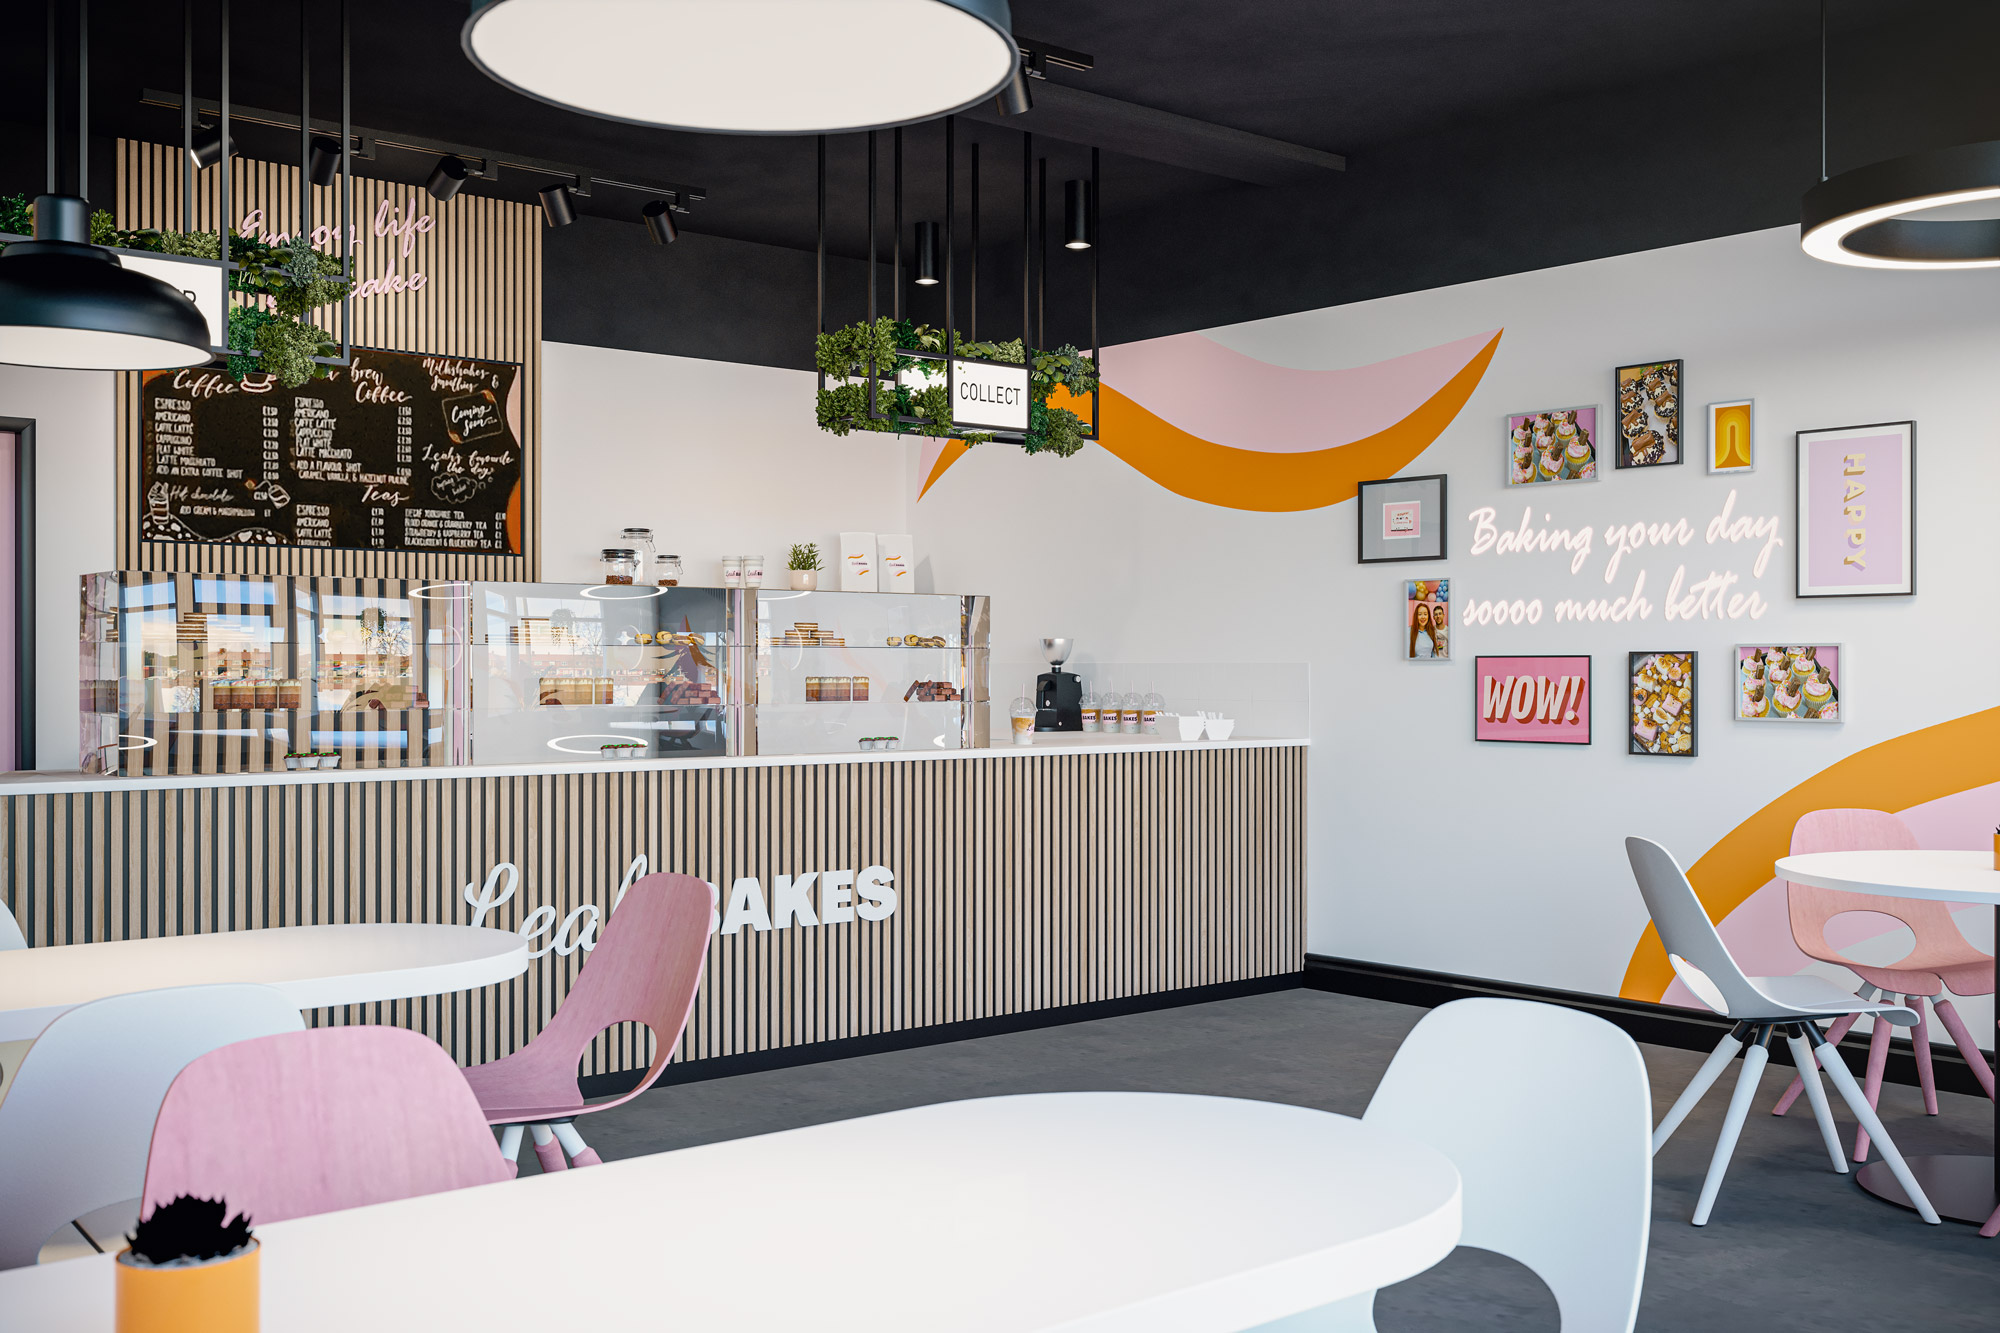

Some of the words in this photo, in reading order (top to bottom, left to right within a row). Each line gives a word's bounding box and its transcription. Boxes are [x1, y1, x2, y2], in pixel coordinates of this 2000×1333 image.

[375, 197, 436, 259] life
[173, 368, 239, 399] Coffee
[355, 381, 413, 404] Coffee
[960, 381, 1021, 405] COLLECT
[451, 405, 492, 423] Coming
[361, 484, 410, 507] Teas
[1843, 453, 1866, 572] HAPPY
[1467, 505, 1594, 575] Baking
[1604, 517, 1695, 584] your
[1705, 488, 1784, 579] day
[1462, 598, 1543, 627] soooo
[1555, 568, 1653, 623] much
[1664, 564, 1768, 621] better
[1483, 675, 1585, 725] WOW!
